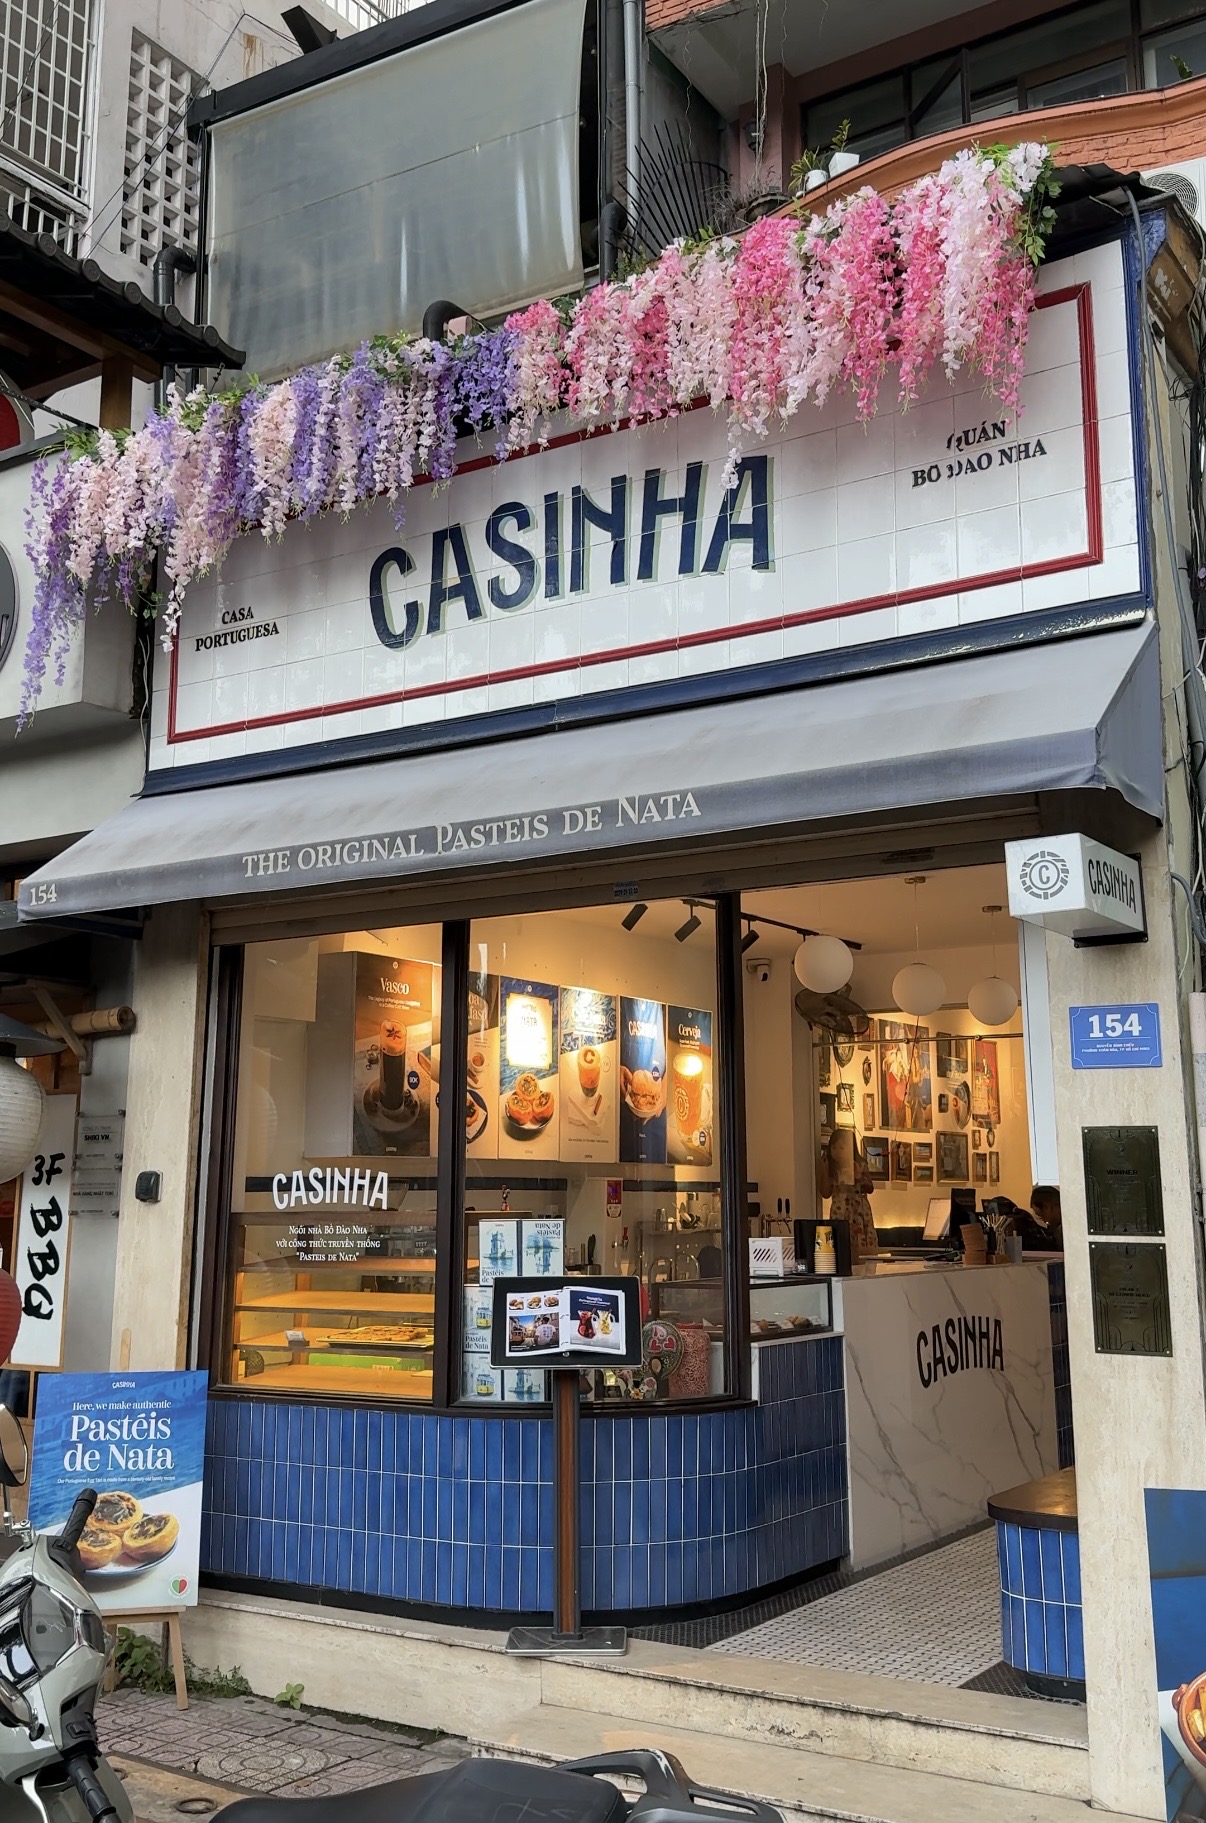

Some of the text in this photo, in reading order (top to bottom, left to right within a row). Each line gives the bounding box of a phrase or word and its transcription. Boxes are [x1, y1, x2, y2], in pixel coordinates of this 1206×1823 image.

[997, 438, 1047, 467] NHA
[369, 455, 773, 650] CASINHA
[221, 606, 254, 625] CASA
[195, 621, 279, 651] PORTUGUESA
[242, 792, 701, 878] THE ORIGINAL PASTEIS DE NATA
[29, 883, 57, 906] 154
[1088, 858, 1137, 914] CASINHA
[380, 977, 410, 995] Vasco
[1088, 1012, 1143, 1038] 154
[272, 1167, 388, 1210] CASINHA
[22, 1153, 65, 1320] 3F BBQ
[916, 1315, 1004, 1388] CASINHA
[112, 1381, 136, 1389] CASINHA
[72, 1402, 95, 1411] Here,
[108, 1401, 132, 1410] make
[132, 1400, 172, 1409] authentic
[69, 1411, 171, 1441] Pastéis
[63, 1443, 175, 1472] de Nata
